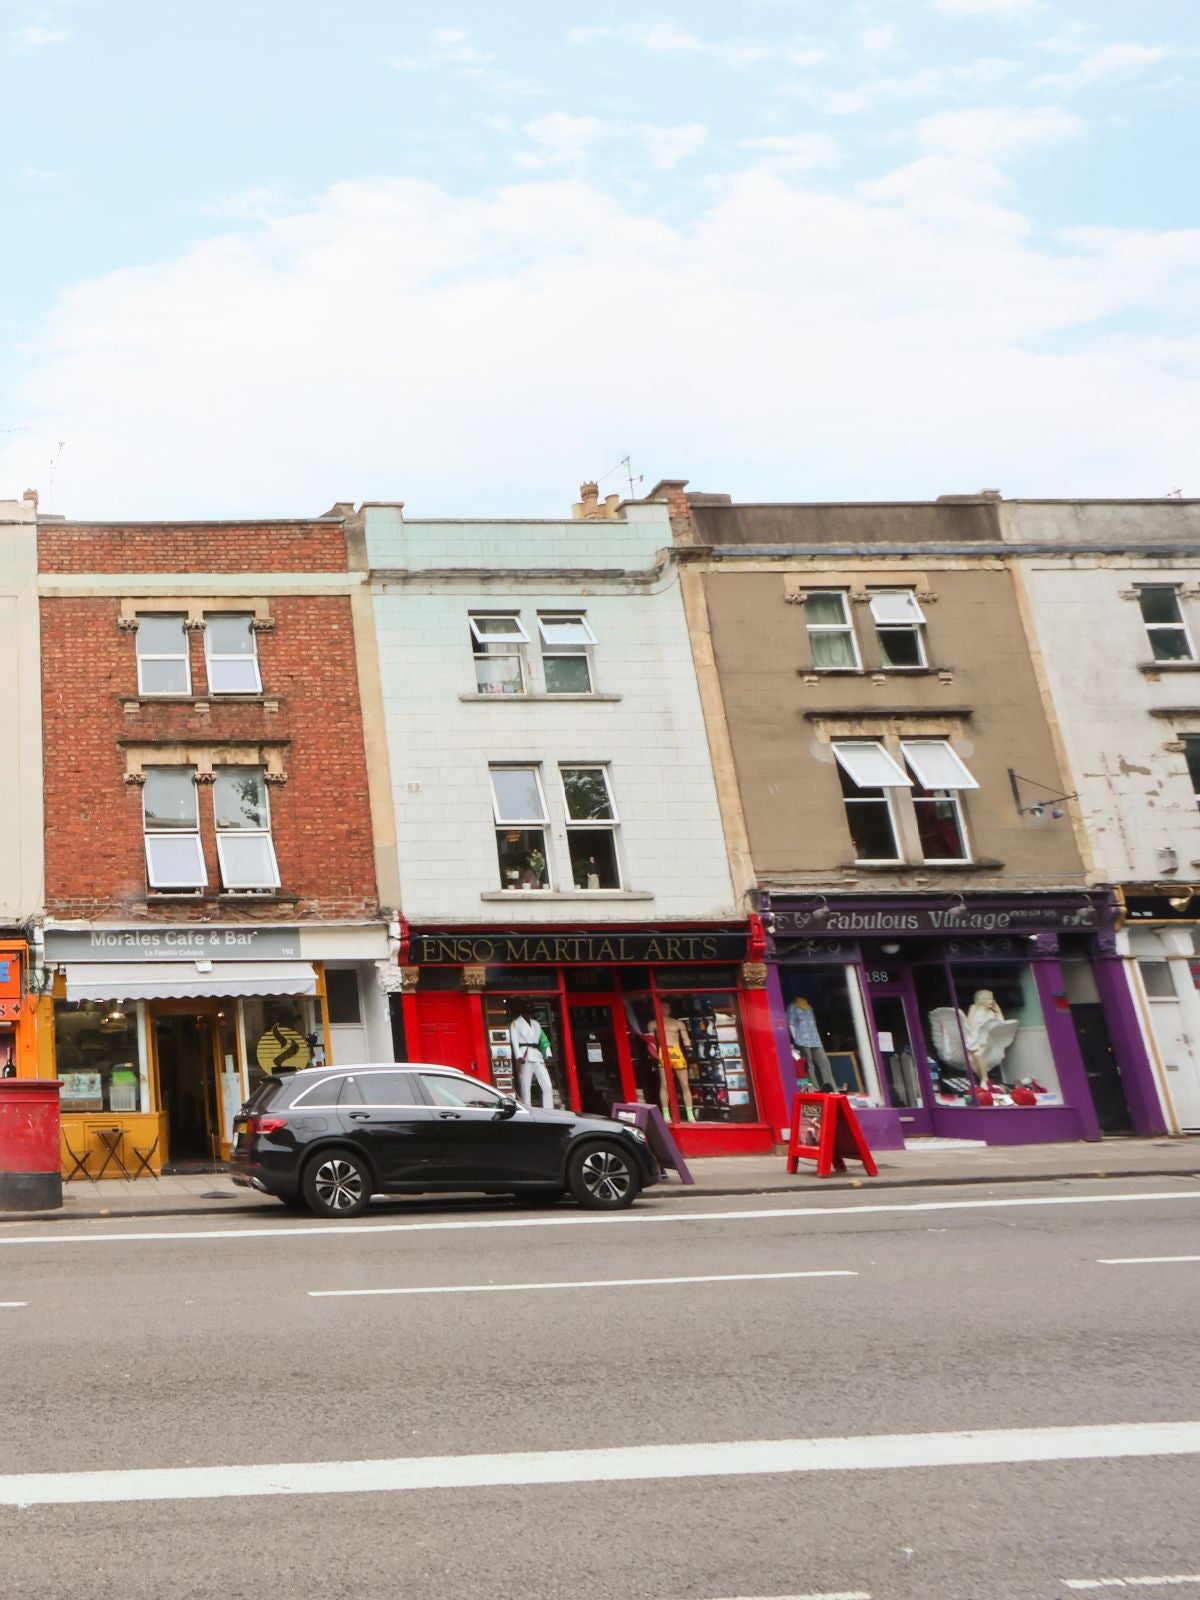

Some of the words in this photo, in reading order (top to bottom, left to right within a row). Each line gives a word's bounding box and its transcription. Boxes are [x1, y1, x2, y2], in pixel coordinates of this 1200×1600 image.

[826, 911, 919, 930] Fabulous
[90, 931, 161, 947] Morales
[164, 931, 206, 946] Cafe
[209, 931, 221, 945] &
[225, 931, 254, 945] Bar
[145, 949, 154, 957] La
[422, 939, 494, 962] ENSO
[506, 938, 634, 961] MARTIAL
[644, 936, 717, 960] ARTS
[864, 971, 889, 983] 188
